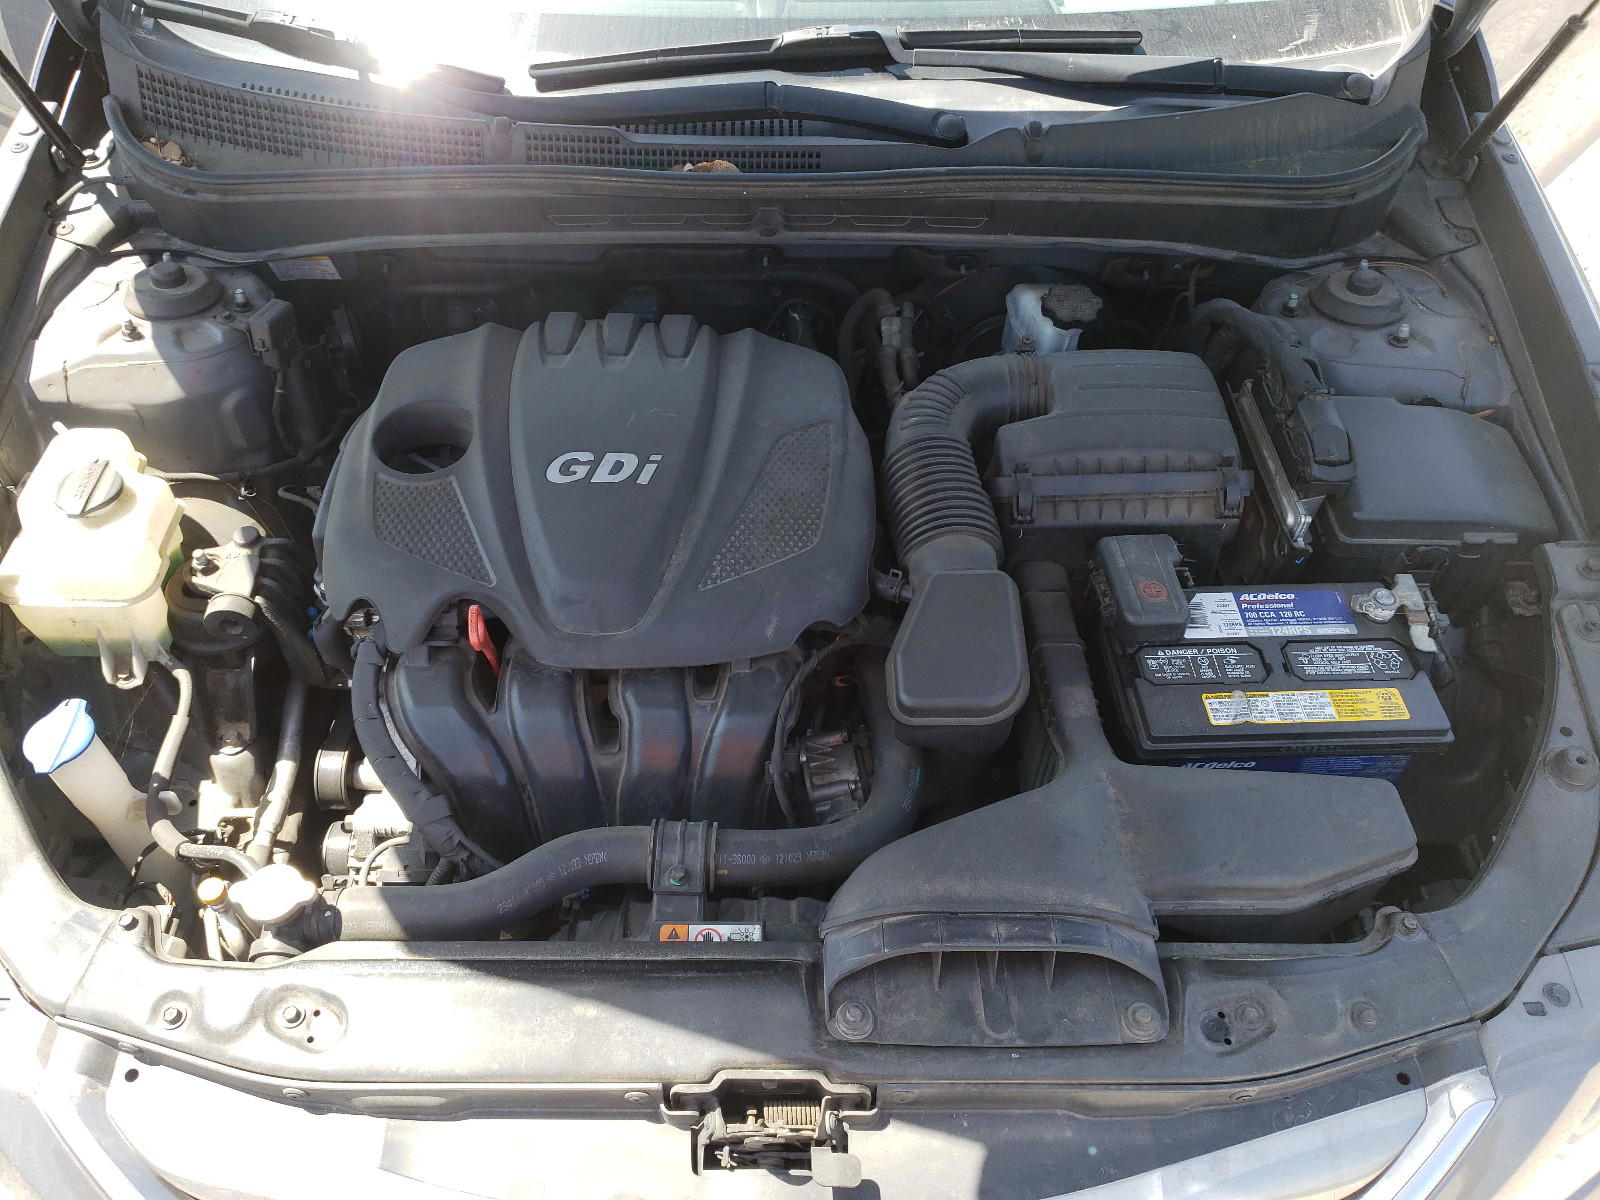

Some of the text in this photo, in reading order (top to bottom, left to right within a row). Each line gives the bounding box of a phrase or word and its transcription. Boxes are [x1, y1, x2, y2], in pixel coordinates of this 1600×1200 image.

[545, 451, 663, 485] GDi
[1239, 592, 1296, 600] ACDelco
[1244, 611, 1257, 619] 700
[1269, 625, 1312, 635] 124RPS
